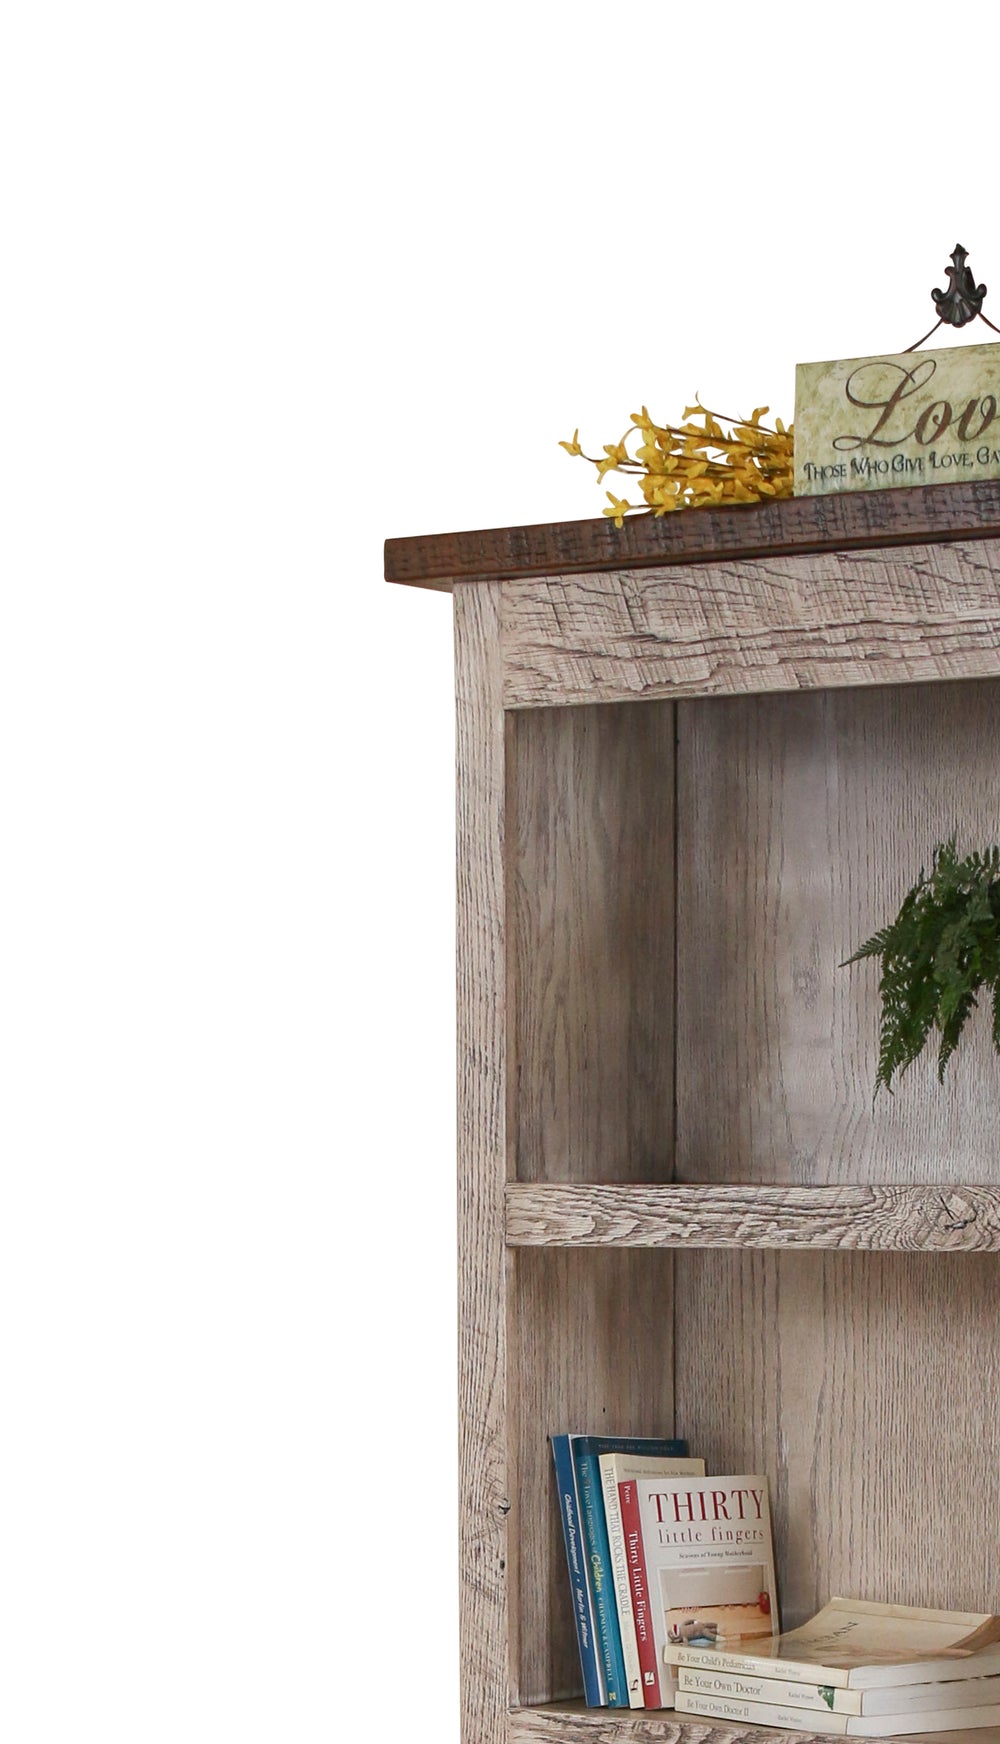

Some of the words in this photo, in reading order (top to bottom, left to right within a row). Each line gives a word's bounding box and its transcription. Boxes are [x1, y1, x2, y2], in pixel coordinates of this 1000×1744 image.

[604, 1467, 616, 1484] THE
[605, 1485, 618, 1510] HAND
[648, 1489, 764, 1523] THIRTY
[609, 1512, 621, 1533] THAT
[629, 1530, 639, 1564] Thirty
[658, 1528, 702, 1544] little
[711, 1526, 765, 1545] fingers
[612, 1535, 625, 1564] ROCKS
[591, 1554, 604, 1593] Children
[616, 1565, 628, 1581] THE
[632, 1567, 644, 1597] Little
[618, 1583, 631, 1617] CRADLE
[636, 1600, 647, 1642] Fingers
[677, 1652, 685, 1660] Be
[686, 1653, 700, 1662] Your
[684, 1675, 693, 1686] Be
[695, 1676, 712, 1689] Your
[714, 1680, 732, 1692] Own
[709, 1702, 722, 1712] Own
[723, 1704, 742, 1715] Doctor
